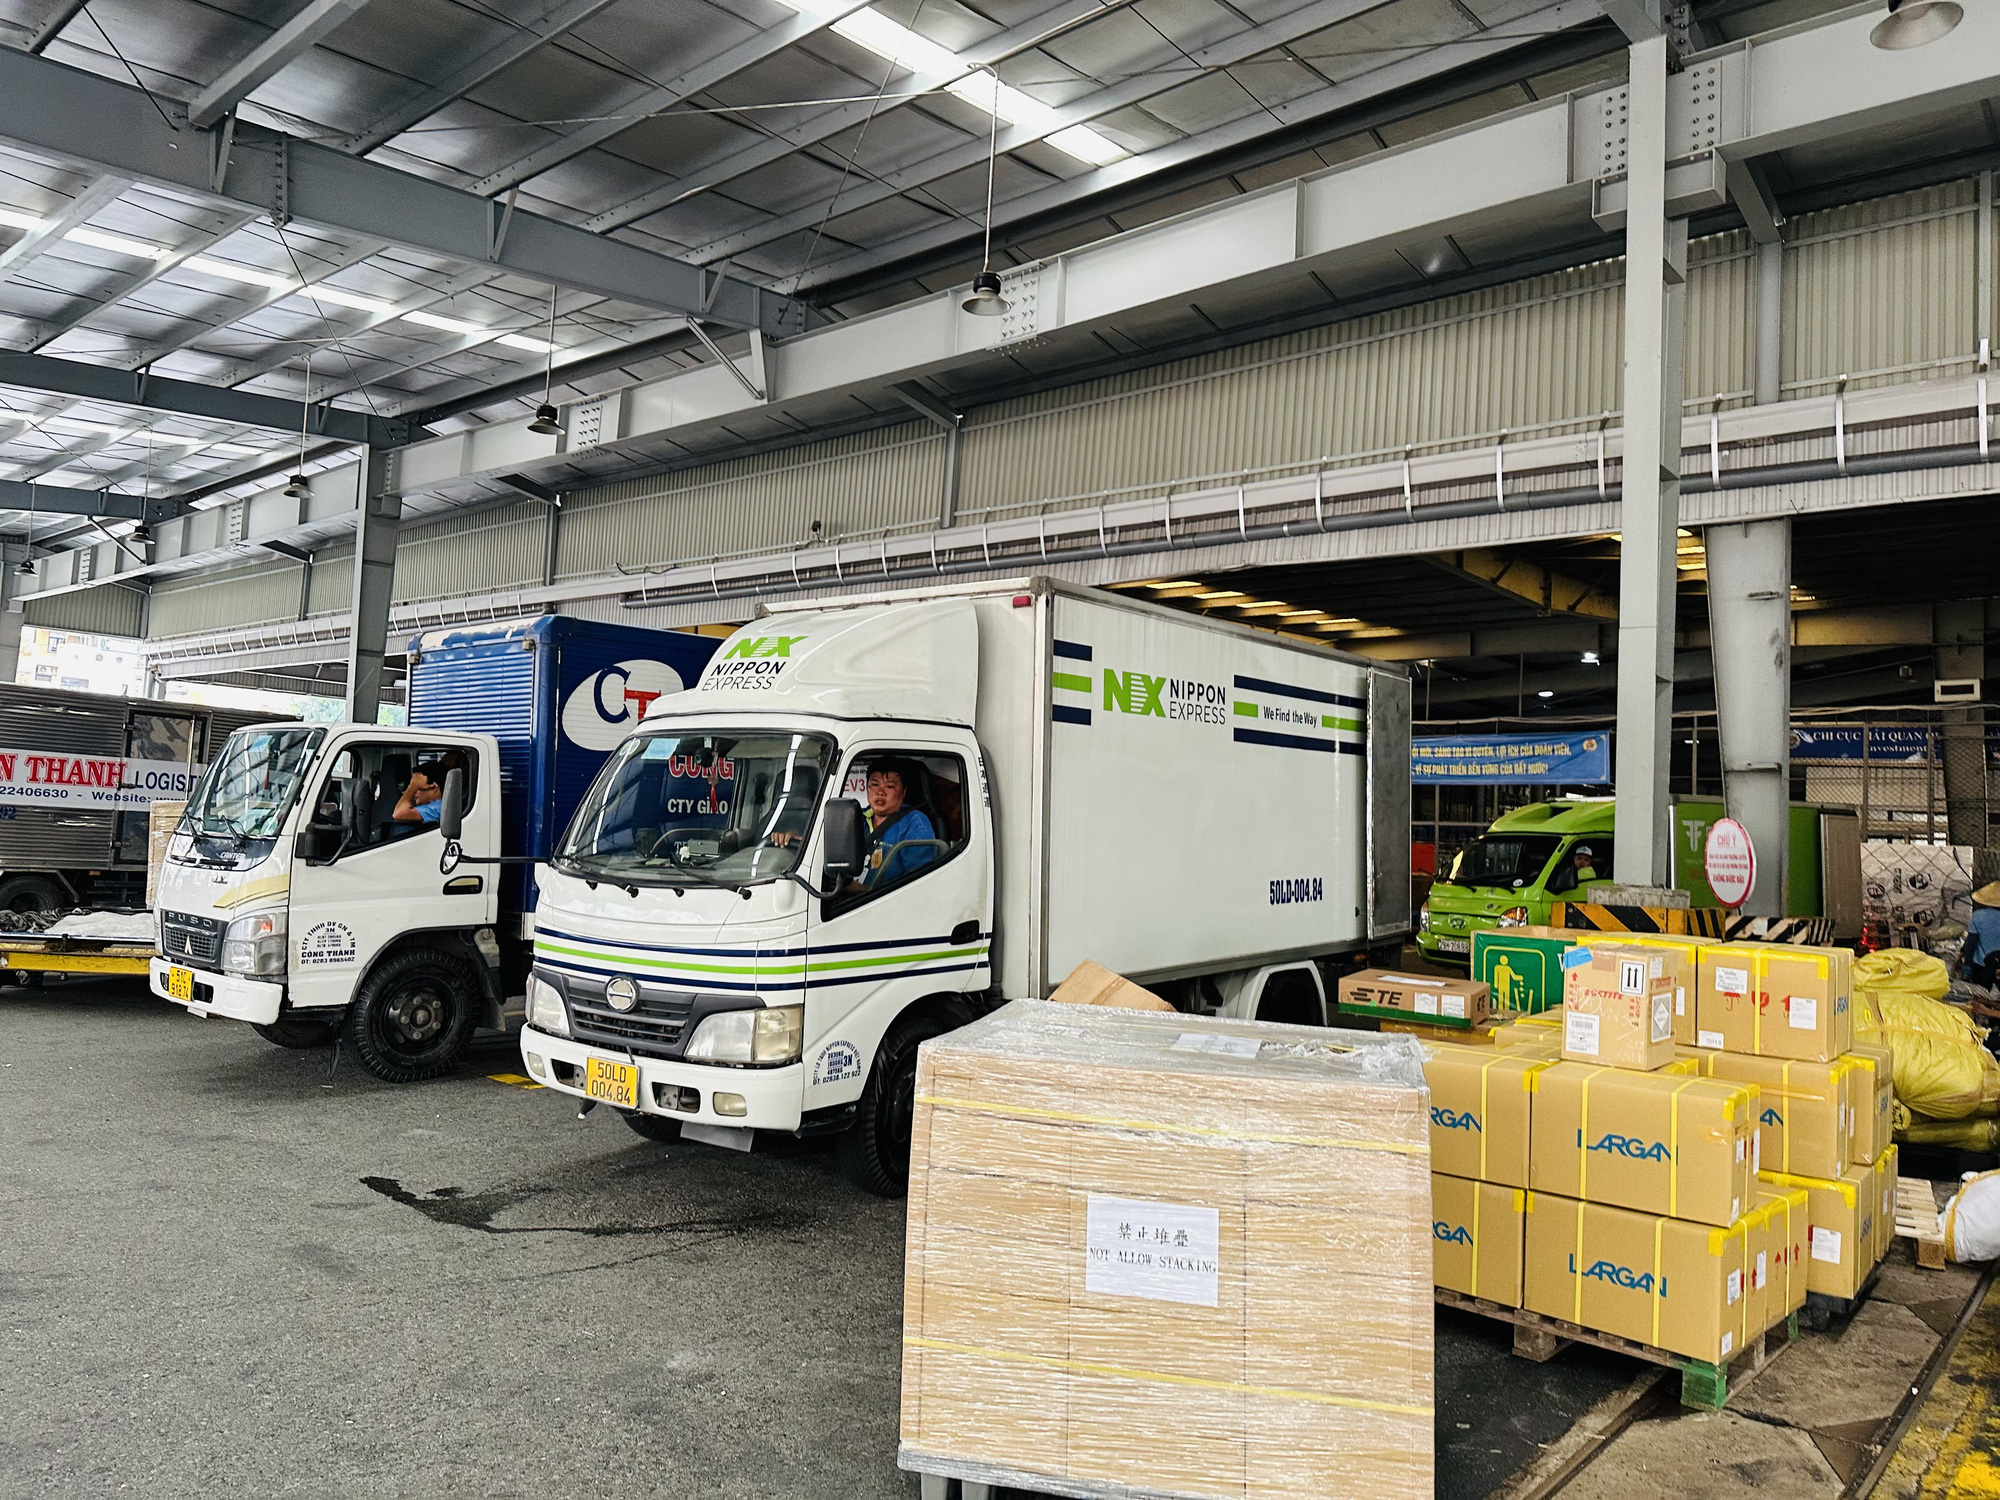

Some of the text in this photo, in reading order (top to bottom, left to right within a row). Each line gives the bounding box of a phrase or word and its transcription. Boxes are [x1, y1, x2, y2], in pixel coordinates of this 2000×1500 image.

[723, 635, 809, 660] NX
[711, 661, 786, 676] NIPPON
[702, 676, 776, 691] EXPRESS
[1103, 668, 1167, 718] NX
[1169, 678, 1226, 706] NIPPON
[1169, 701, 1226, 725] EXPRESS
[1263, 706, 1318, 729] We Find the Way
[1813, 731, 1833, 741] CHI
[1888, 731, 1923, 743] QUAN
[1868, 743, 1928, 753] nvestment
[24, 755, 128, 789] THANH
[134, 770, 201, 793] LOGIST
[91, 791, 151, 804] Website:
[667, 798, 694, 814] CTY
[1269, 877, 1323, 905] 50LD-004.84
[168, 911, 213, 927] FUSO
[1377, 989, 1403, 1006] TE
[597, 1061, 627, 1083] 50LD
[843, 1053, 853, 1067] 3N
[591, 1079, 631, 1104] 004.84
[1576, 1128, 1679, 1166] LARGAN
[1118, 1221, 1189, 1248] 禁止堆疊
[1432, 1220, 1474, 1247] GAN
[1089, 1246, 1217, 1274] NOT ALLOW STACKING
[1568, 1252, 1668, 1299] LARGAN
